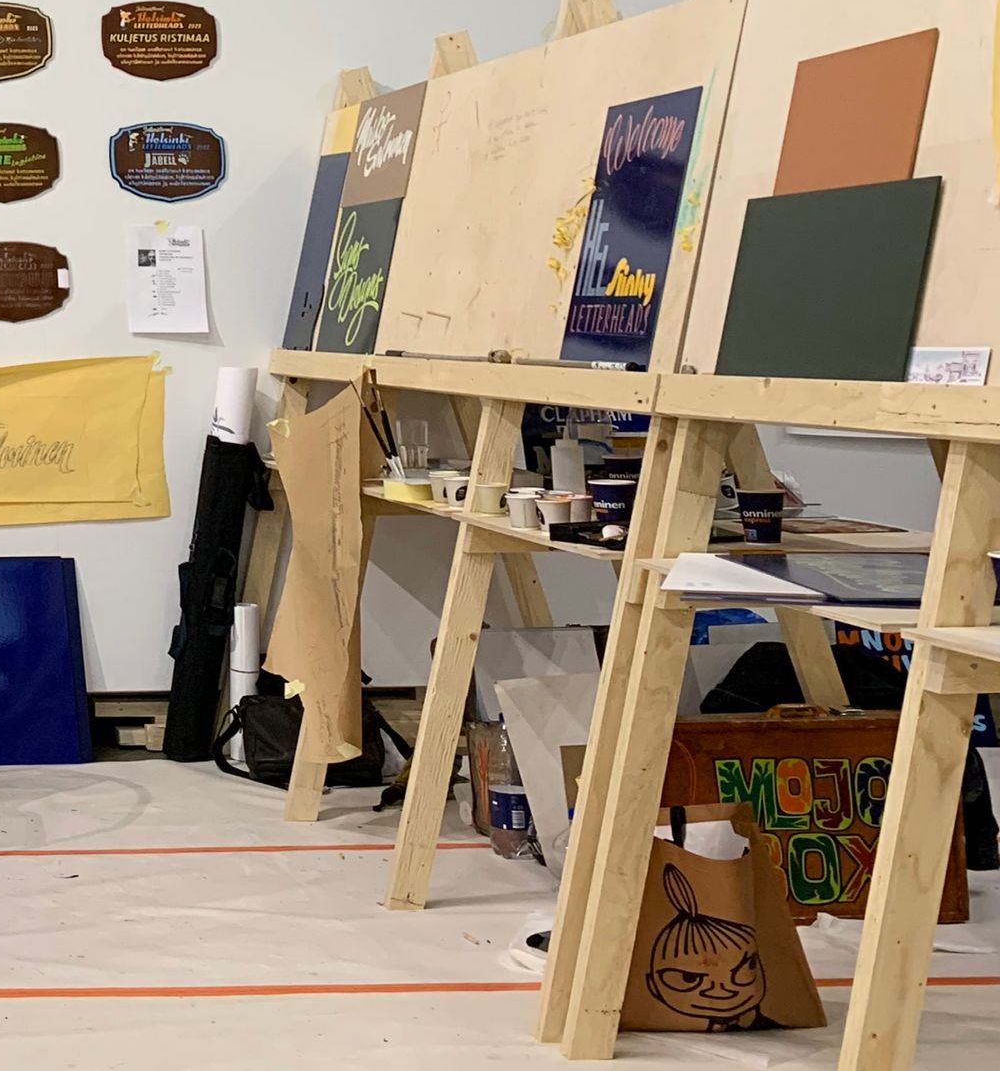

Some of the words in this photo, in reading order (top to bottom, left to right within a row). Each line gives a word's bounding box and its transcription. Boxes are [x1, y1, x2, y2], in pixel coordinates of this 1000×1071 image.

[136, 11, 182, 23] Helsinki
[110, 33, 158, 43] KULJETUS
[160, 33, 210, 42] RISTIMAA
[145, 133, 190, 144] Helsinki
[603, 106, 685, 175] Welcome
[570, 303, 652, 335] LETTERHEADS
[714, 757, 893, 831] MOJO
